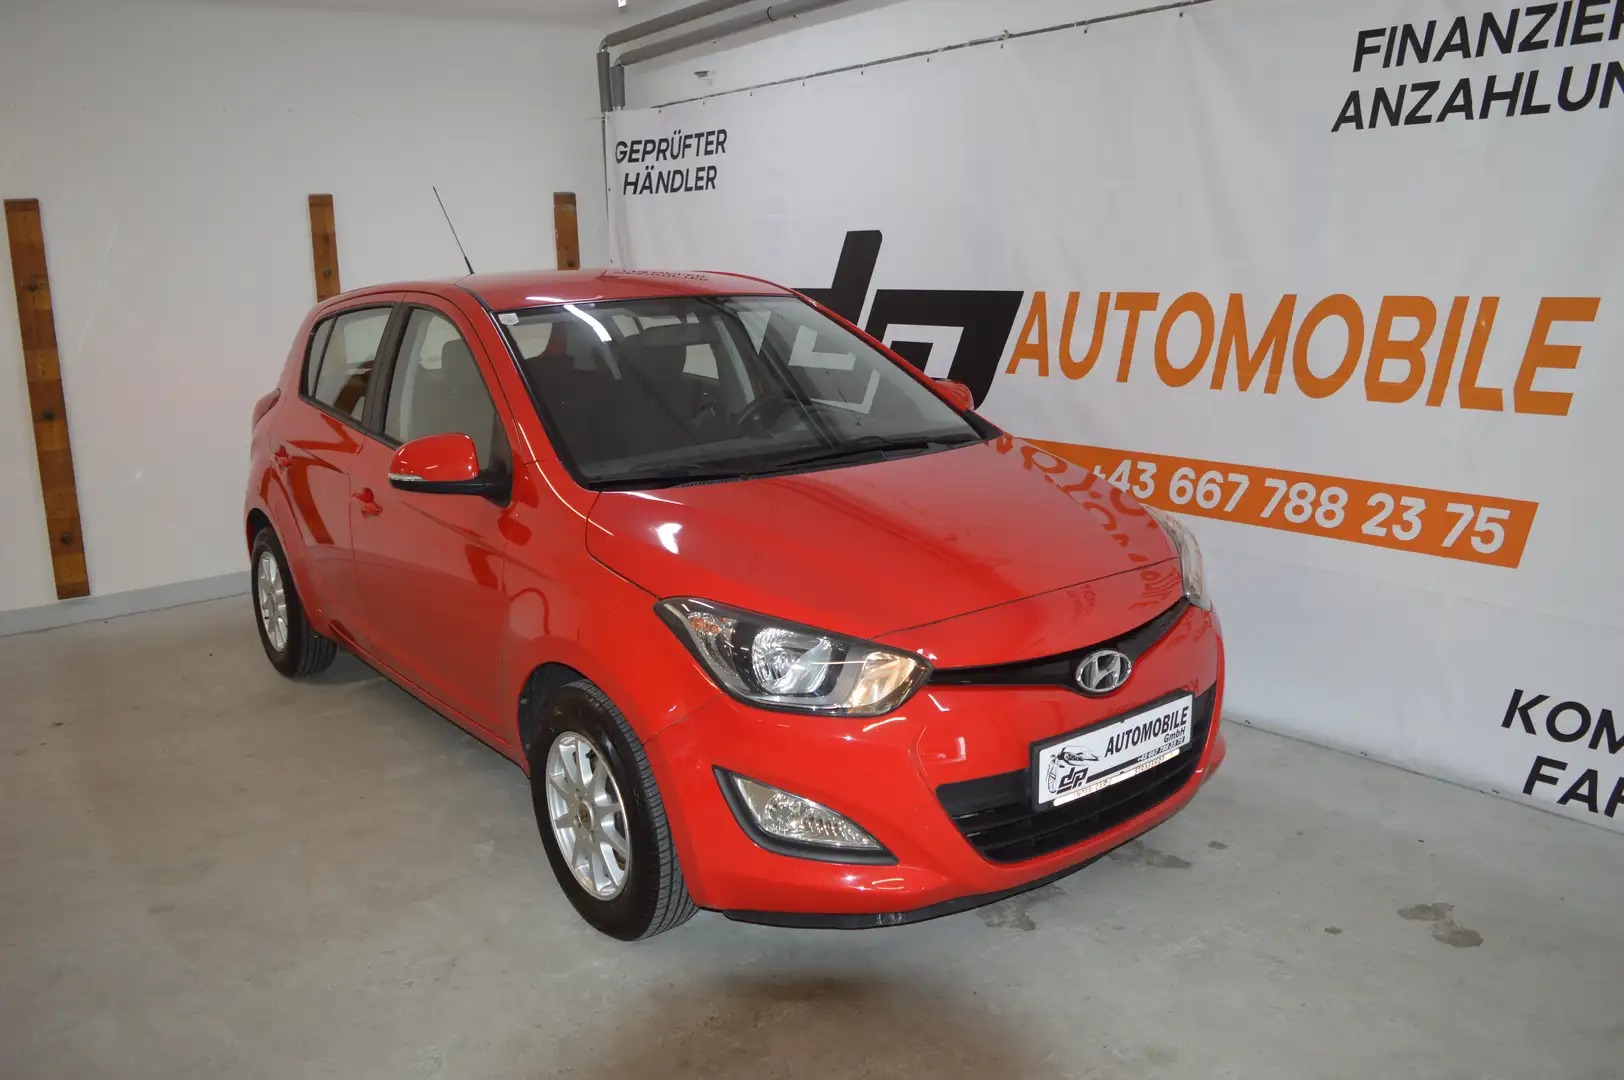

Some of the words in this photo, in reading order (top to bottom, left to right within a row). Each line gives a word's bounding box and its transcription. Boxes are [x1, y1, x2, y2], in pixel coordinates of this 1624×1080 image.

[615, 128, 727, 163] GEPRÜFTER
[623, 165, 717, 195] HÄNDLER
[1005, 291, 1601, 416] AUTOMOBILE
[1169, 467, 1249, 512] 667
[1260, 478, 1348, 528] 788
[1361, 493, 1426, 541] 23
[1441, 503, 1511, 554] 75
[1104, 706, 1189, 758] AUTOMOBILE
[1164, 726, 1186, 743] GmbH
